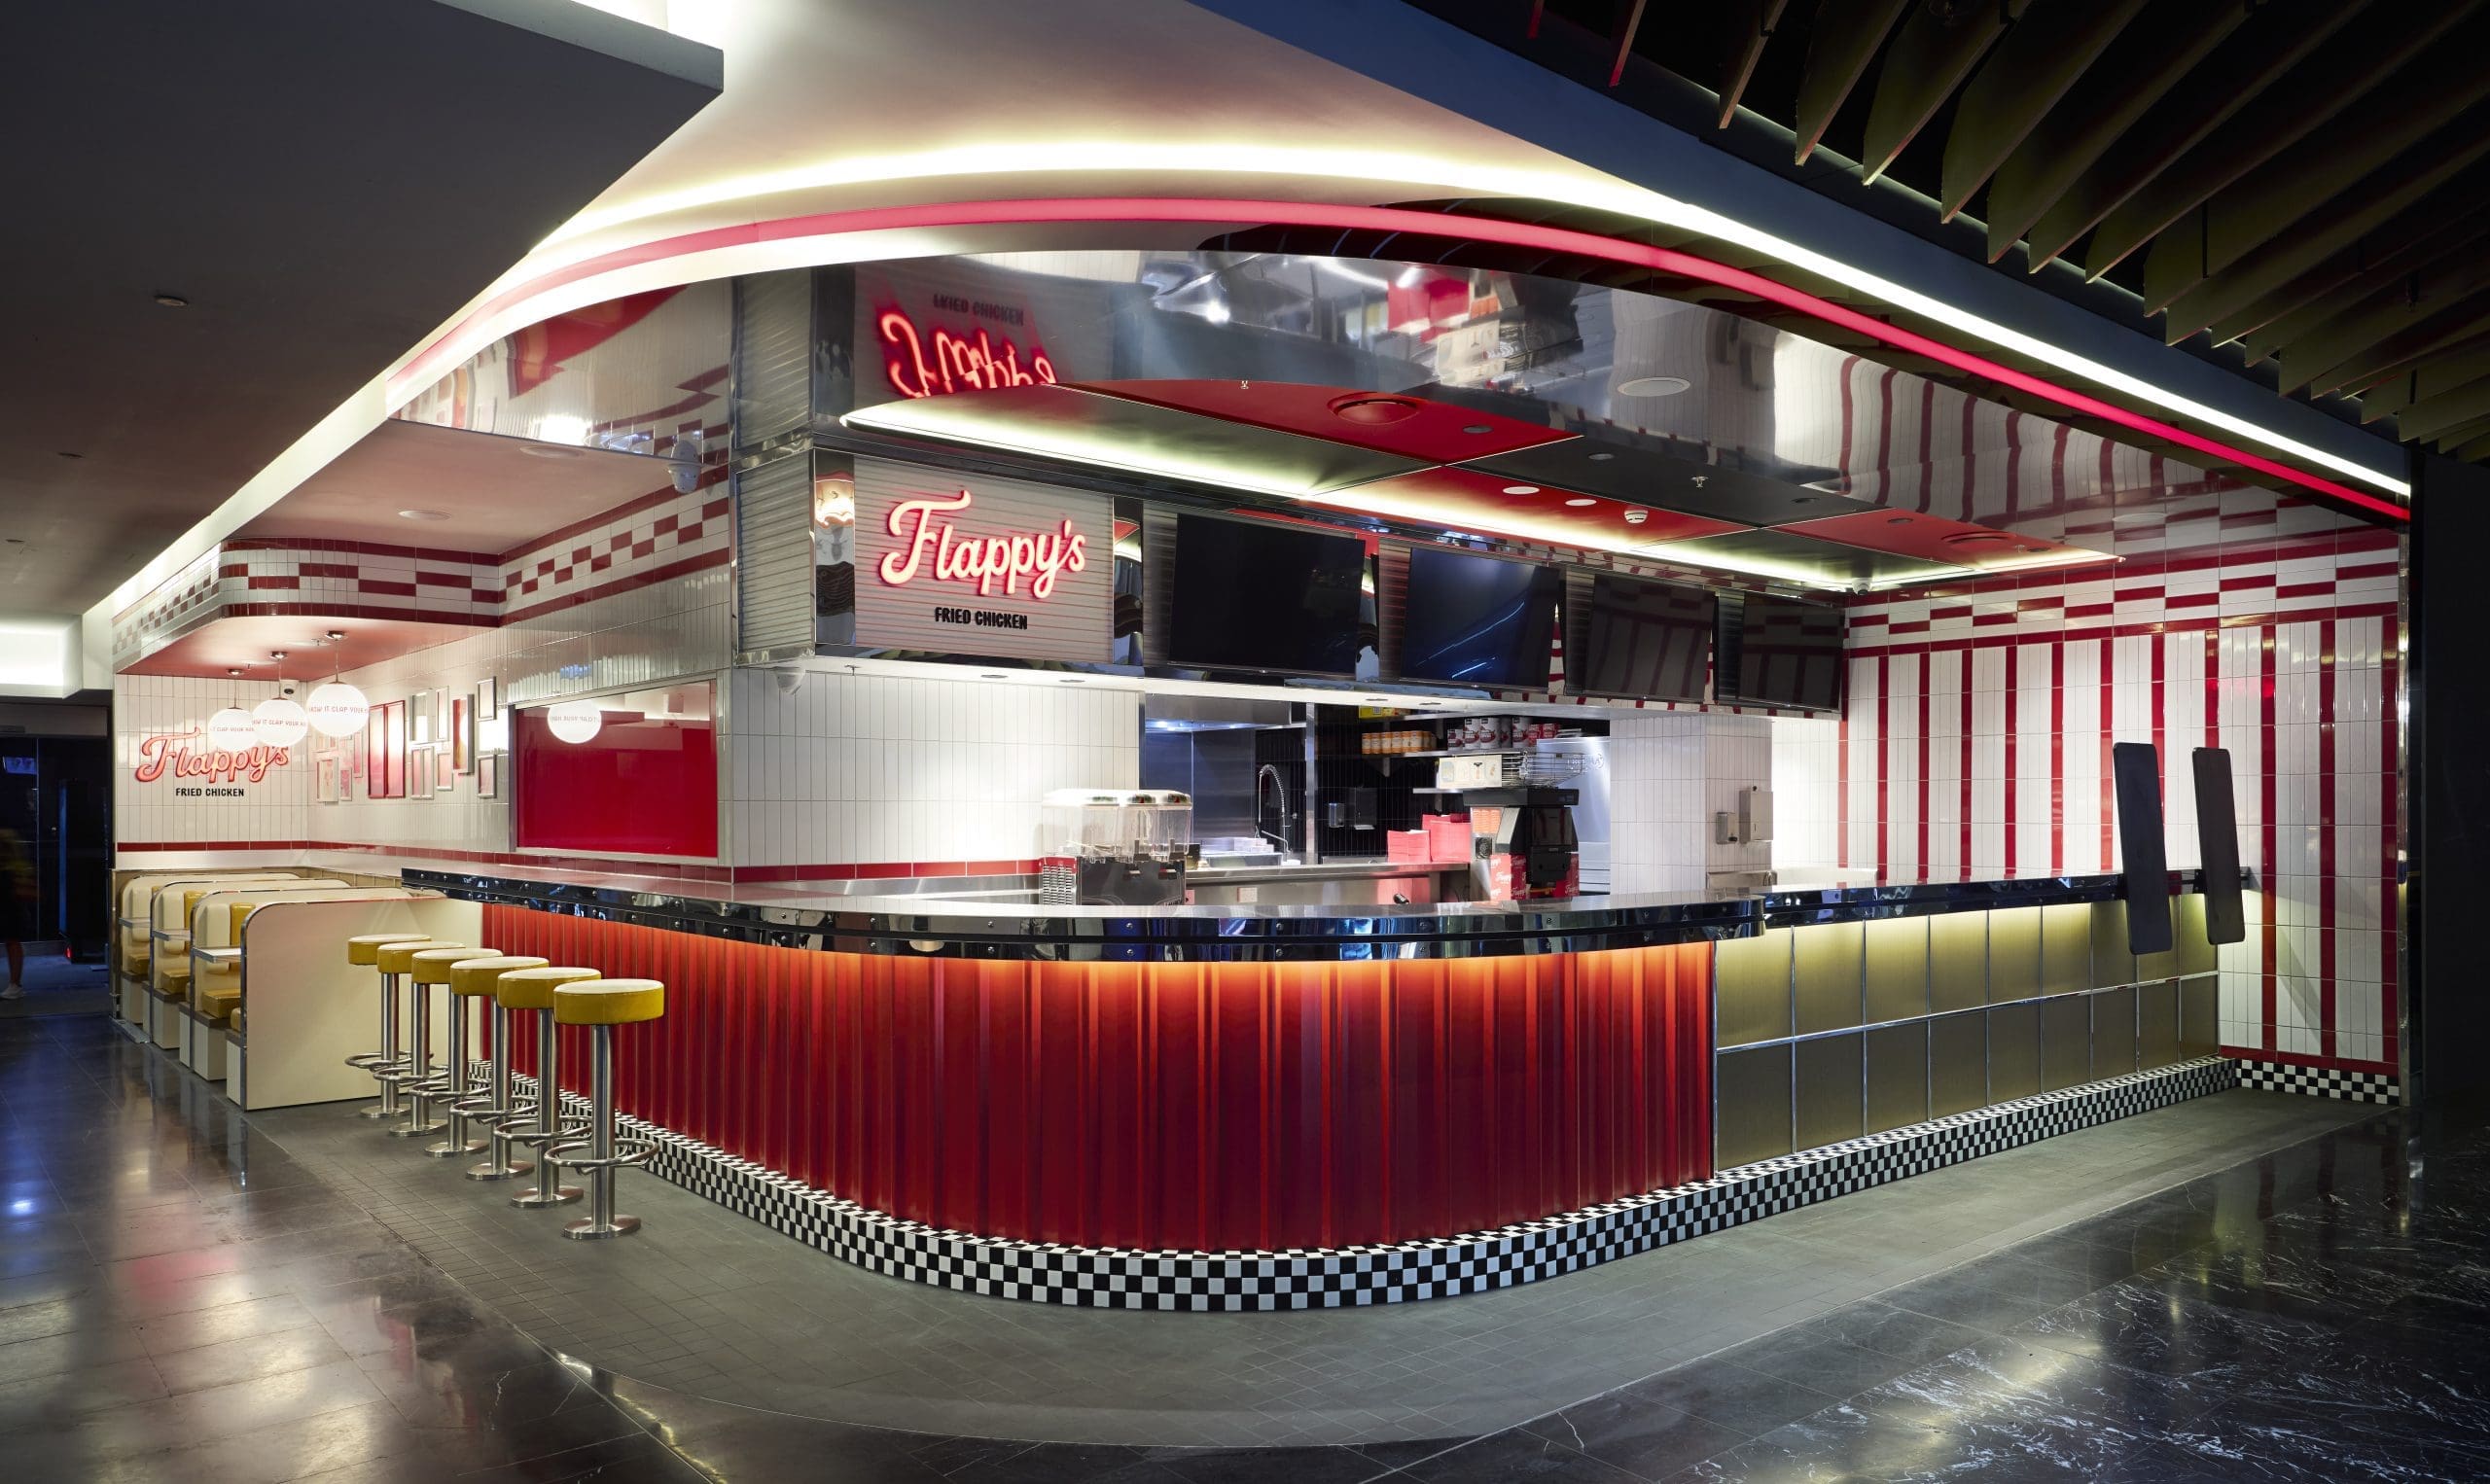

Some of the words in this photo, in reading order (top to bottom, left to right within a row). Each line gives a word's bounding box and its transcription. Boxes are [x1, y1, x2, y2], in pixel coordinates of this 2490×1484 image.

[879, 489, 1086, 599] Flappy's
[935, 607, 971, 624] FRIED
[975, 611, 1028, 630] CHICKEN
[135, 726, 289, 783] Flappys
[175, 788, 202, 796] FRIED
[205, 788, 244, 796] CHICKEN
